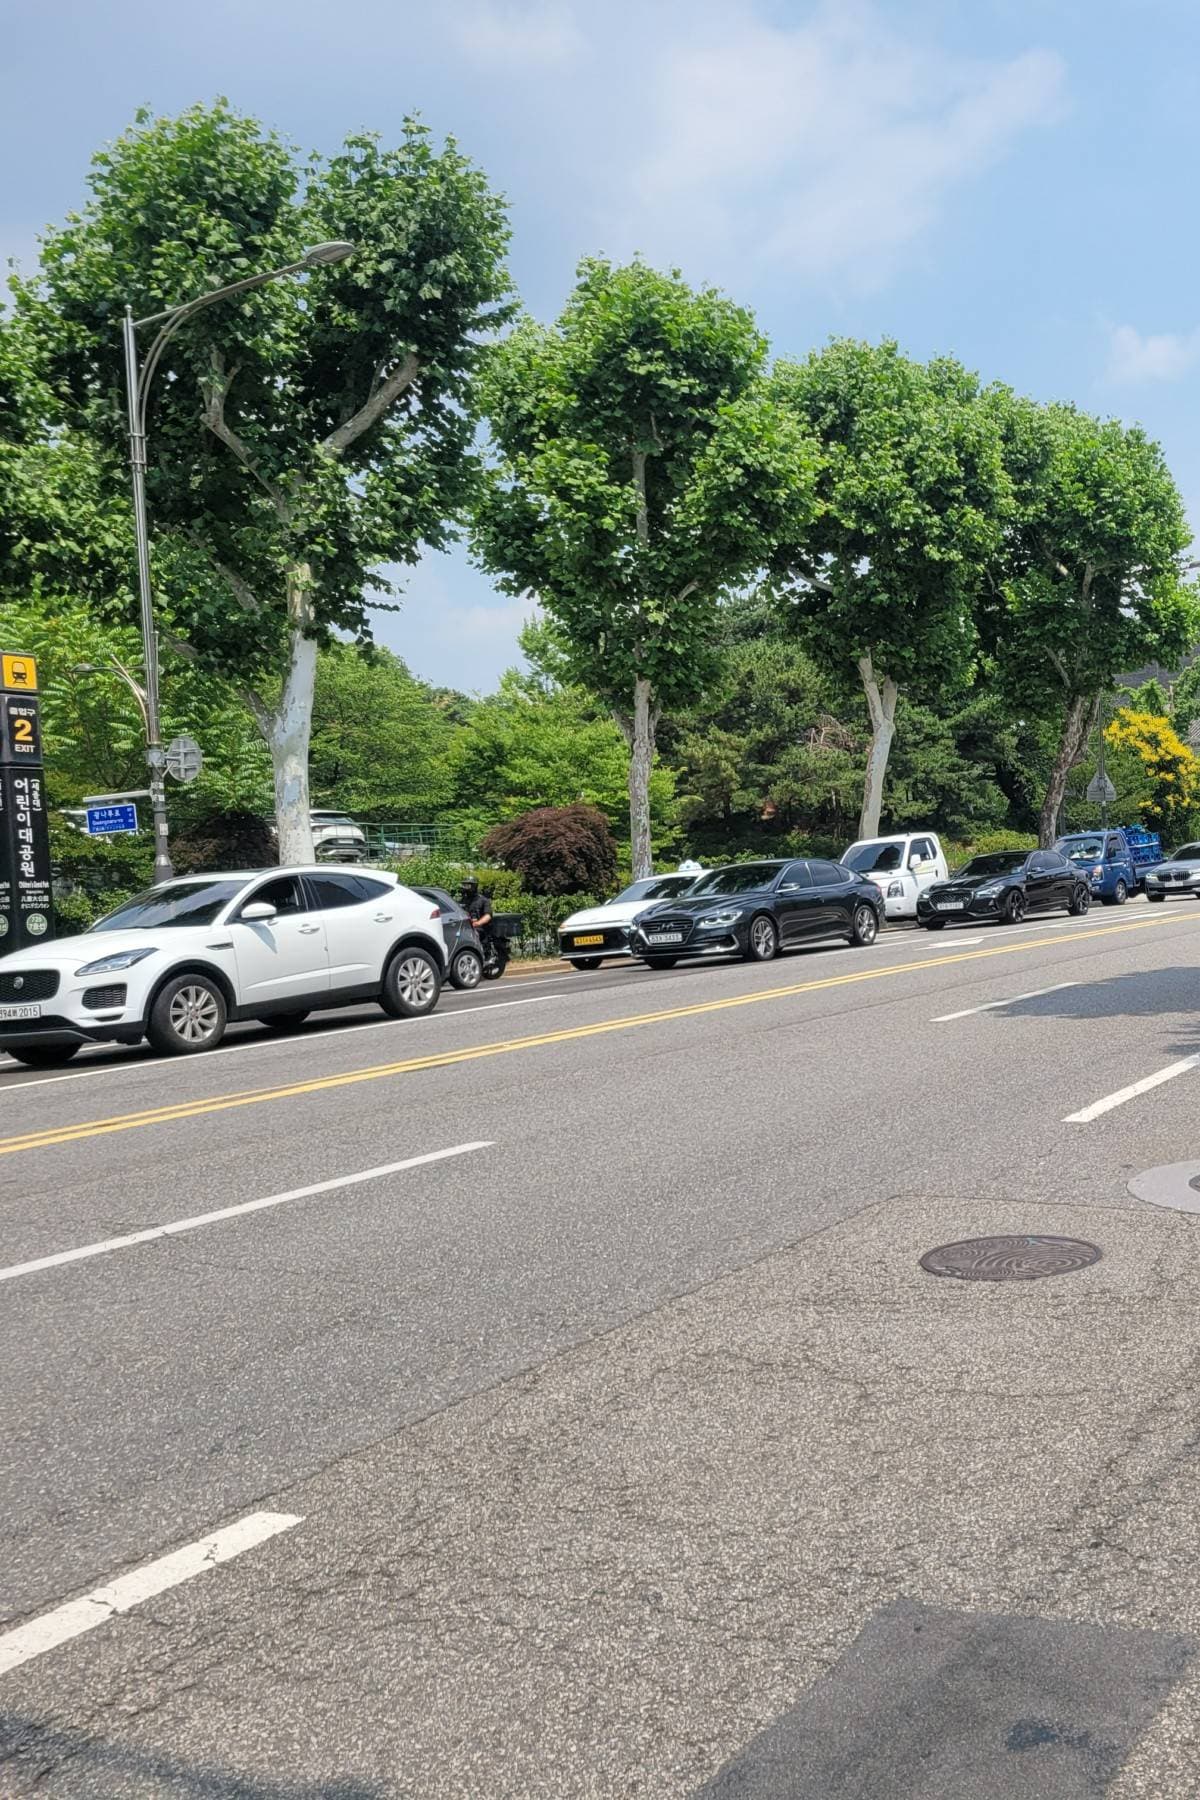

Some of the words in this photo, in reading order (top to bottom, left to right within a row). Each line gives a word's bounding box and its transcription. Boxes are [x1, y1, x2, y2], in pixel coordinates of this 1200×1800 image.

[14, 719, 33, 741] 2
[14, 744, 36, 753] EXIT
[14, 777, 36, 878] 어린이대공원
